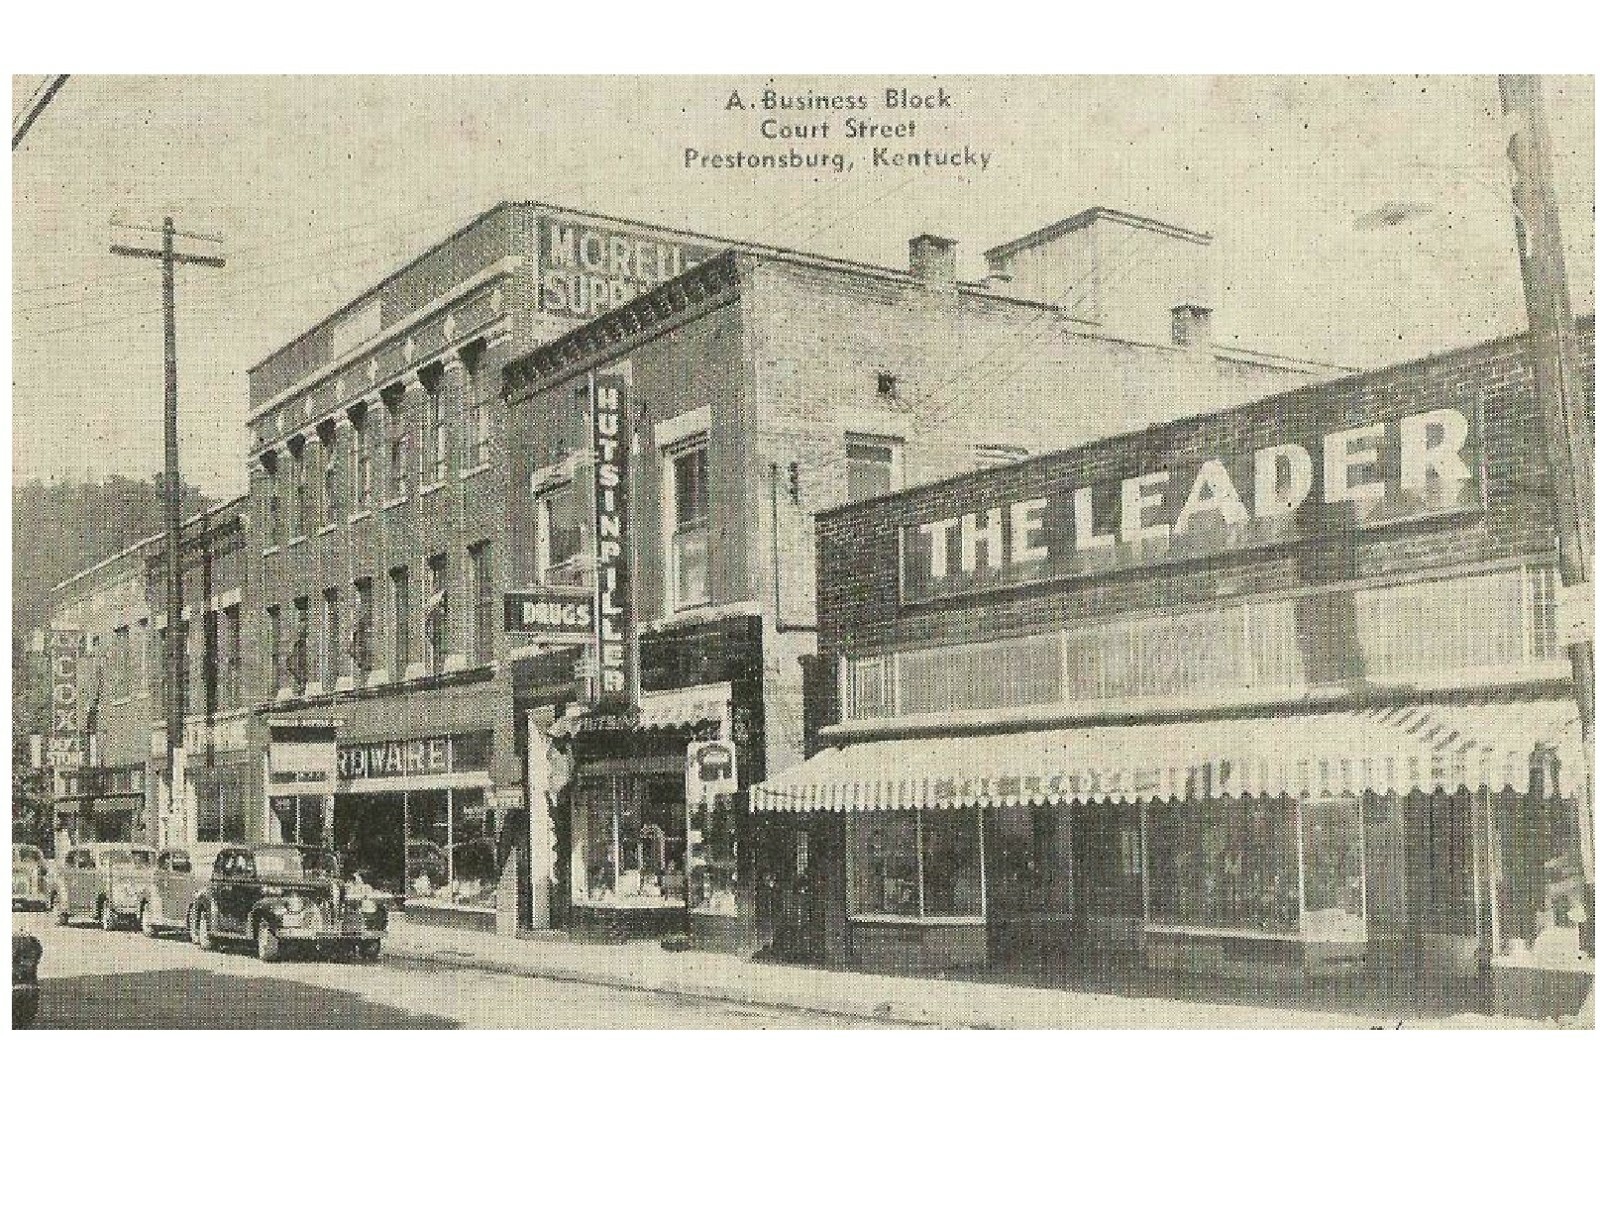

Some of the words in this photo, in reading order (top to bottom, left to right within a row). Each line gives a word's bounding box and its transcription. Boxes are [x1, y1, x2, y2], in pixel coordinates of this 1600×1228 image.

[919, 498, 1049, 580] THE
[1073, 407, 1473, 551] LEADER
[598, 387, 625, 692] HUTSINPILLER
[522, 600, 591, 626] DRUGS
[53, 656, 76, 731] COX
[338, 739, 447, 777] RDWARE
